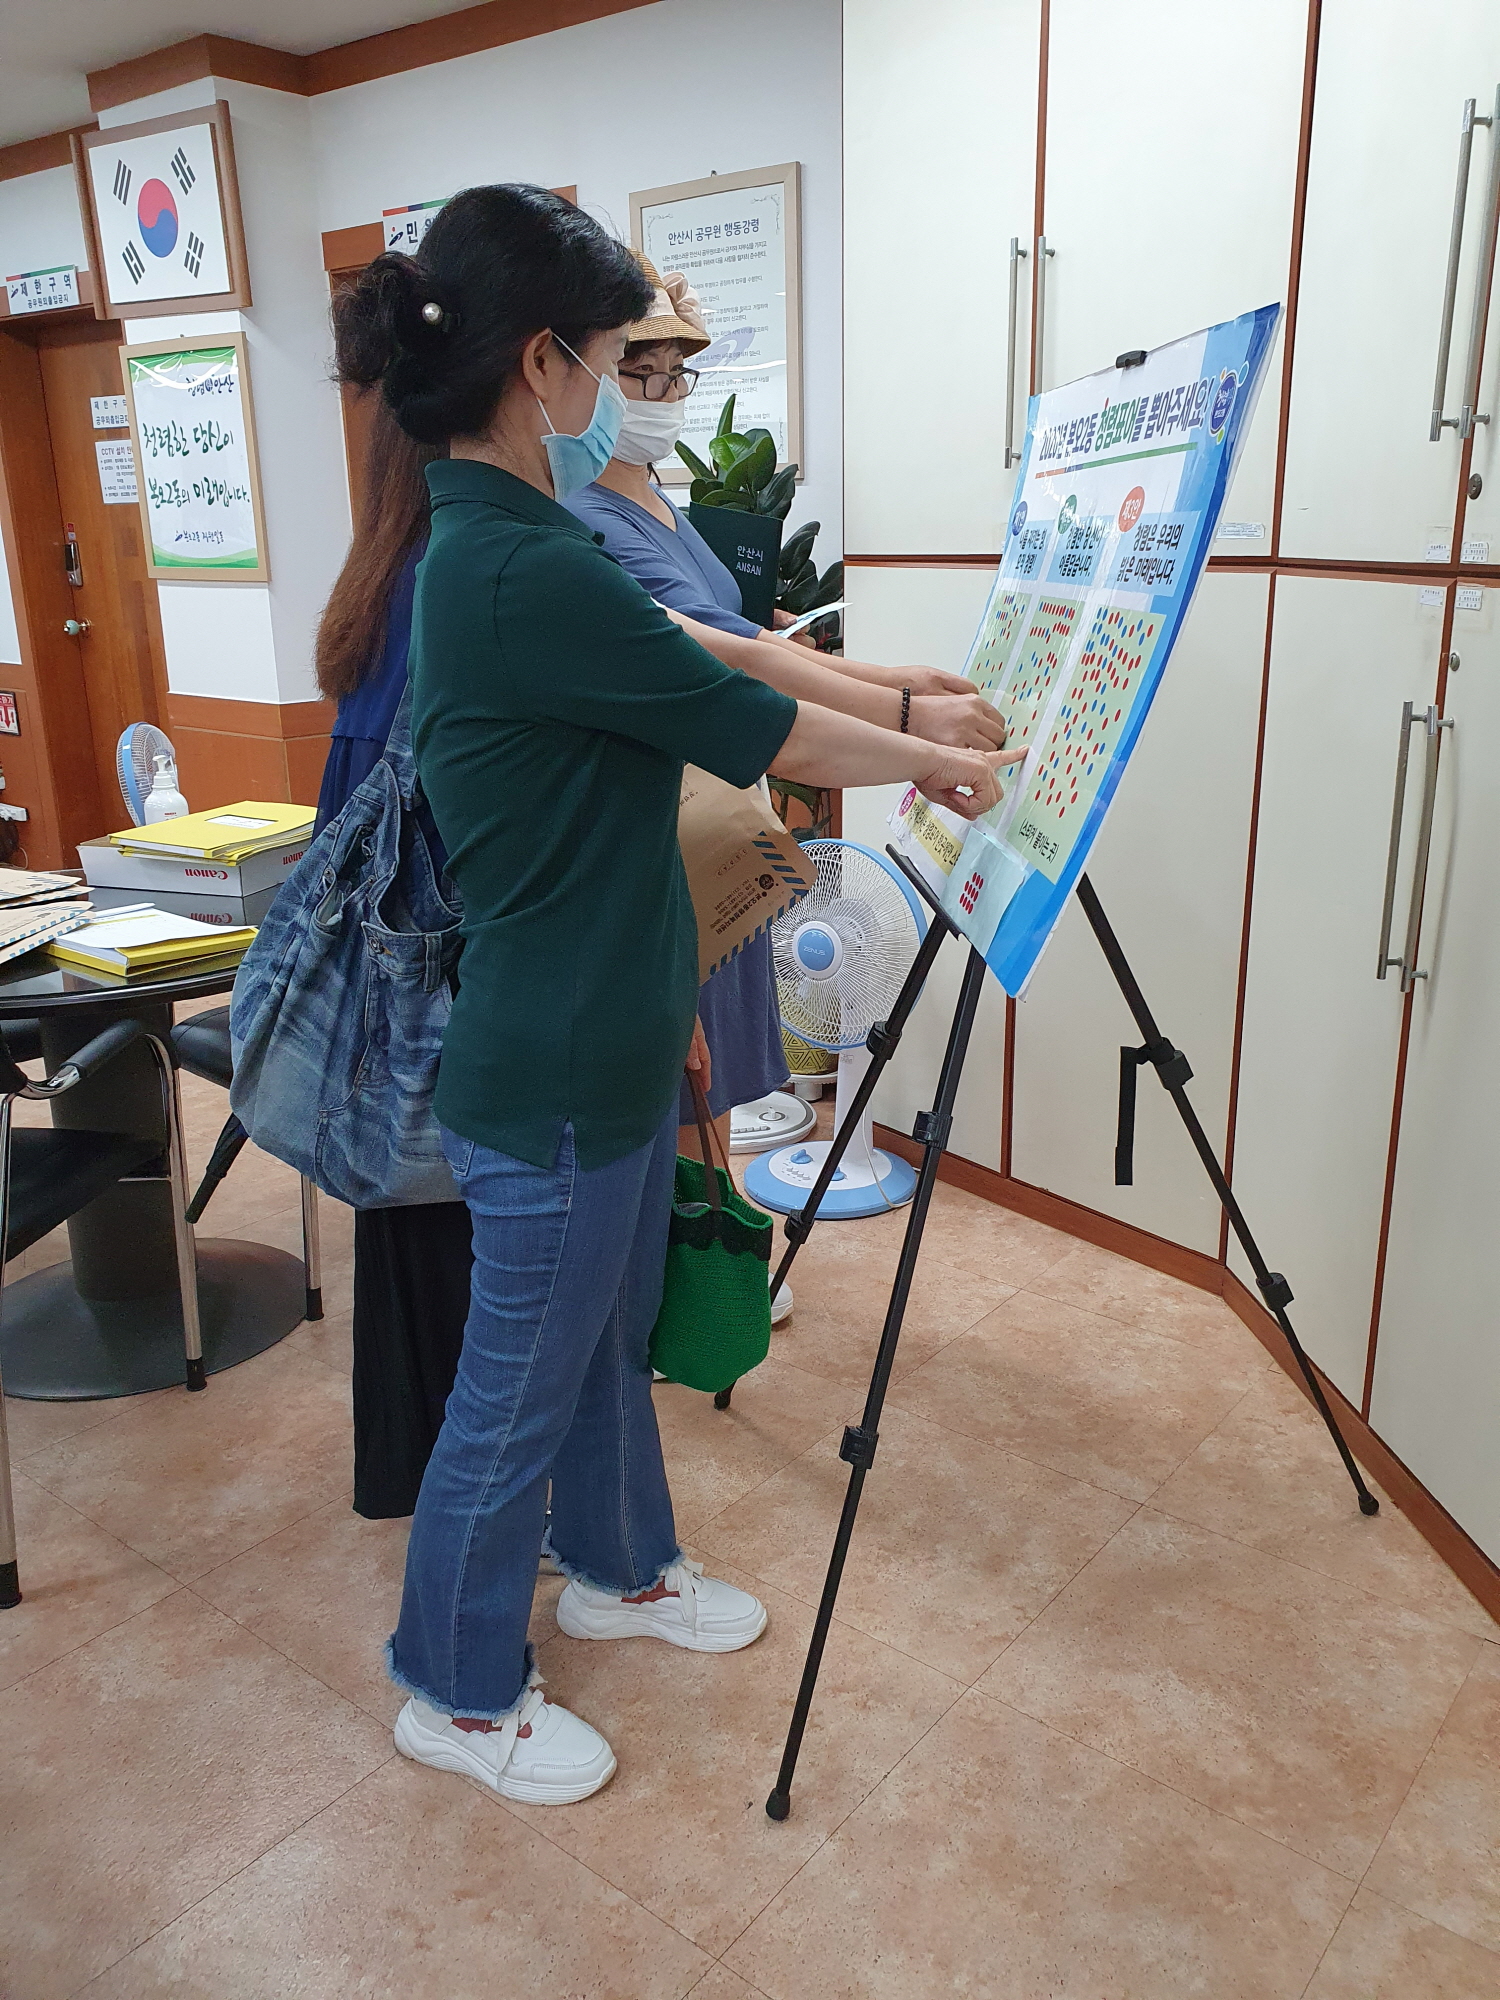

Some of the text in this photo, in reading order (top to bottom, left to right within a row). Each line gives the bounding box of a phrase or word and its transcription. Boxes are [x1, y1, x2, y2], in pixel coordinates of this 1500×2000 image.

[667, 218, 760, 246] 안산시 공무원 행동강령
[1094, 397, 1150, 452] 청렴표어를
[1143, 377, 1216, 440] 뽑아주세요!
[101, 448, 114, 456] CCTV
[142, 420, 234, 458] 청렴한 당신이
[193, 476, 251, 508] 미래입니다.
[1121, 499, 1142, 520] 제3안
[1133, 522, 1158, 551] 청렴은
[1156, 523, 1184, 551] 우리의
[736, 545, 764, 561] 안산시
[1058, 553, 1093, 577] 아름답습니다.
[735, 561, 762, 576] ANSAN
[1116, 555, 1176, 586] 밝은 미래입니다.
[1018, 817, 1038, 845] (스티커
[282, 851, 304, 865] anon
[184, 868, 228, 880] Canon
